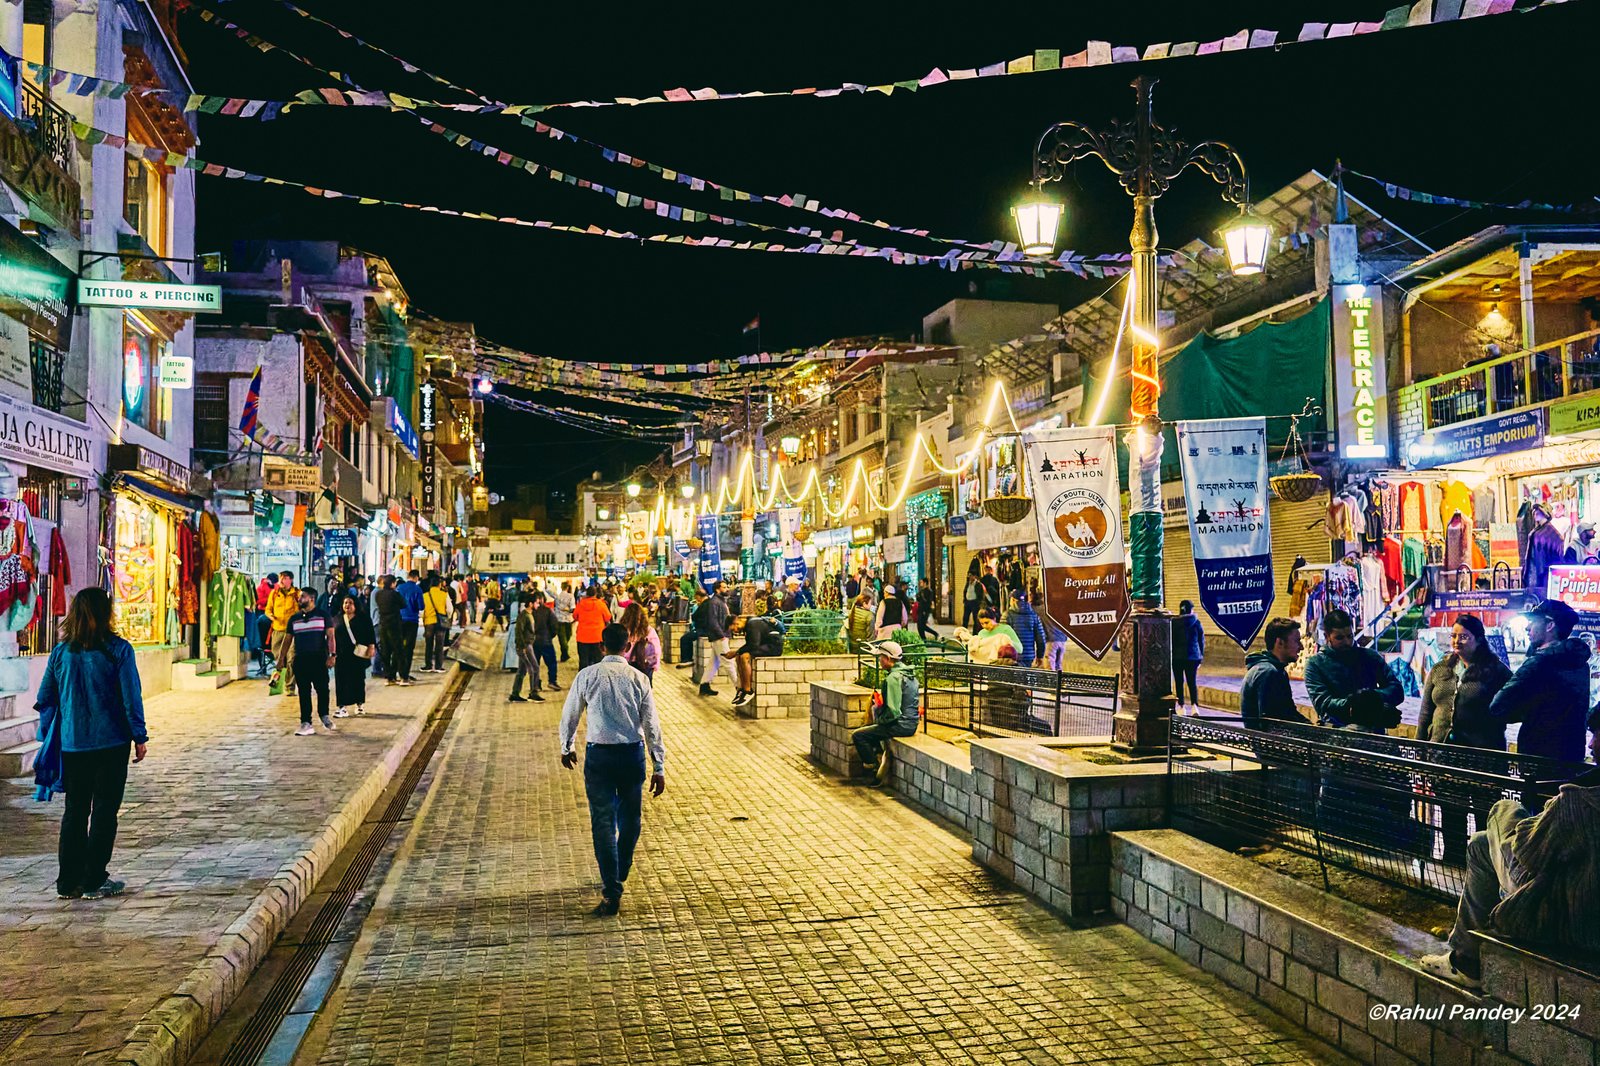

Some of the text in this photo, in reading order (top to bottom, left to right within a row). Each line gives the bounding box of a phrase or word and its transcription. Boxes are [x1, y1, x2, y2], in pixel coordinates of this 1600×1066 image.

[85, 287, 214, 302] TATTOO & PIERCING
[1346, 297, 1371, 308] THE
[1351, 309, 1375, 446] TERRACE
[25, 420, 92, 463] GALLERY
[1484, 424, 1537, 447] EMPORIUM
[424, 443, 433, 503] Travel
[1043, 470, 1104, 481] MARATHON
[1051, 499, 1063, 511] SILK
[1063, 490, 1085, 499] ROUTE
[1088, 492, 1105, 508] ULTRA
[1198, 522, 1264, 534] MARATHON
[329, 547, 353, 556] ATM
[1063, 545, 1085, 557] Beyond
[1094, 540, 1109, 554] Limits
[1201, 569, 1218, 578] For
[1220, 568, 1235, 577] the
[1064, 574, 1116, 588] Beyond All
[1207, 581, 1227, 591] and
[1228, 580, 1243, 590] the
[1077, 589, 1107, 600] Limits
[1223, 601, 1260, 614] 11155ft
[1075, 612, 1113, 624] 122 km
